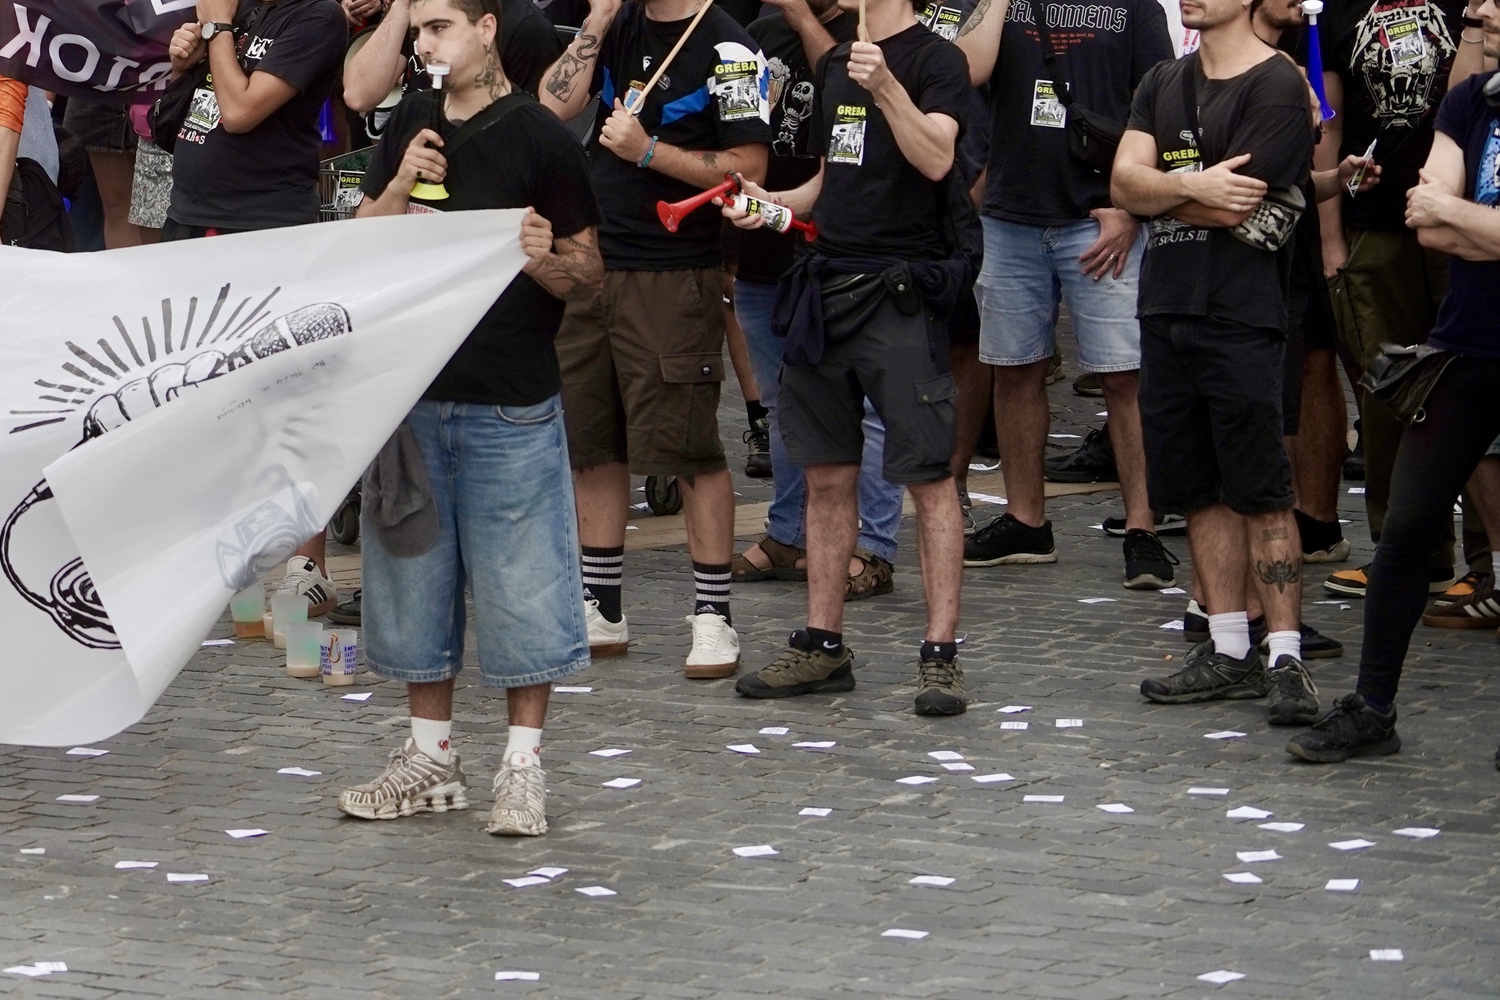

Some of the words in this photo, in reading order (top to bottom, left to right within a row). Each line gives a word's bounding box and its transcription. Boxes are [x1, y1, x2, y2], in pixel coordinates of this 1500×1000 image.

[1046, 3, 1127, 33] OMENS
[1387, 23, 1417, 36] GREBA
[715, 61, 757, 74] GREBA
[1037, 86, 1054, 94] GRE
[837, 105, 866, 116] GREBA
[1163, 149, 1200, 161] GREBA
[341, 176, 360, 184] GREB
[1158, 230, 1195, 246] SOULS
[1196, 230, 1209, 241] III
